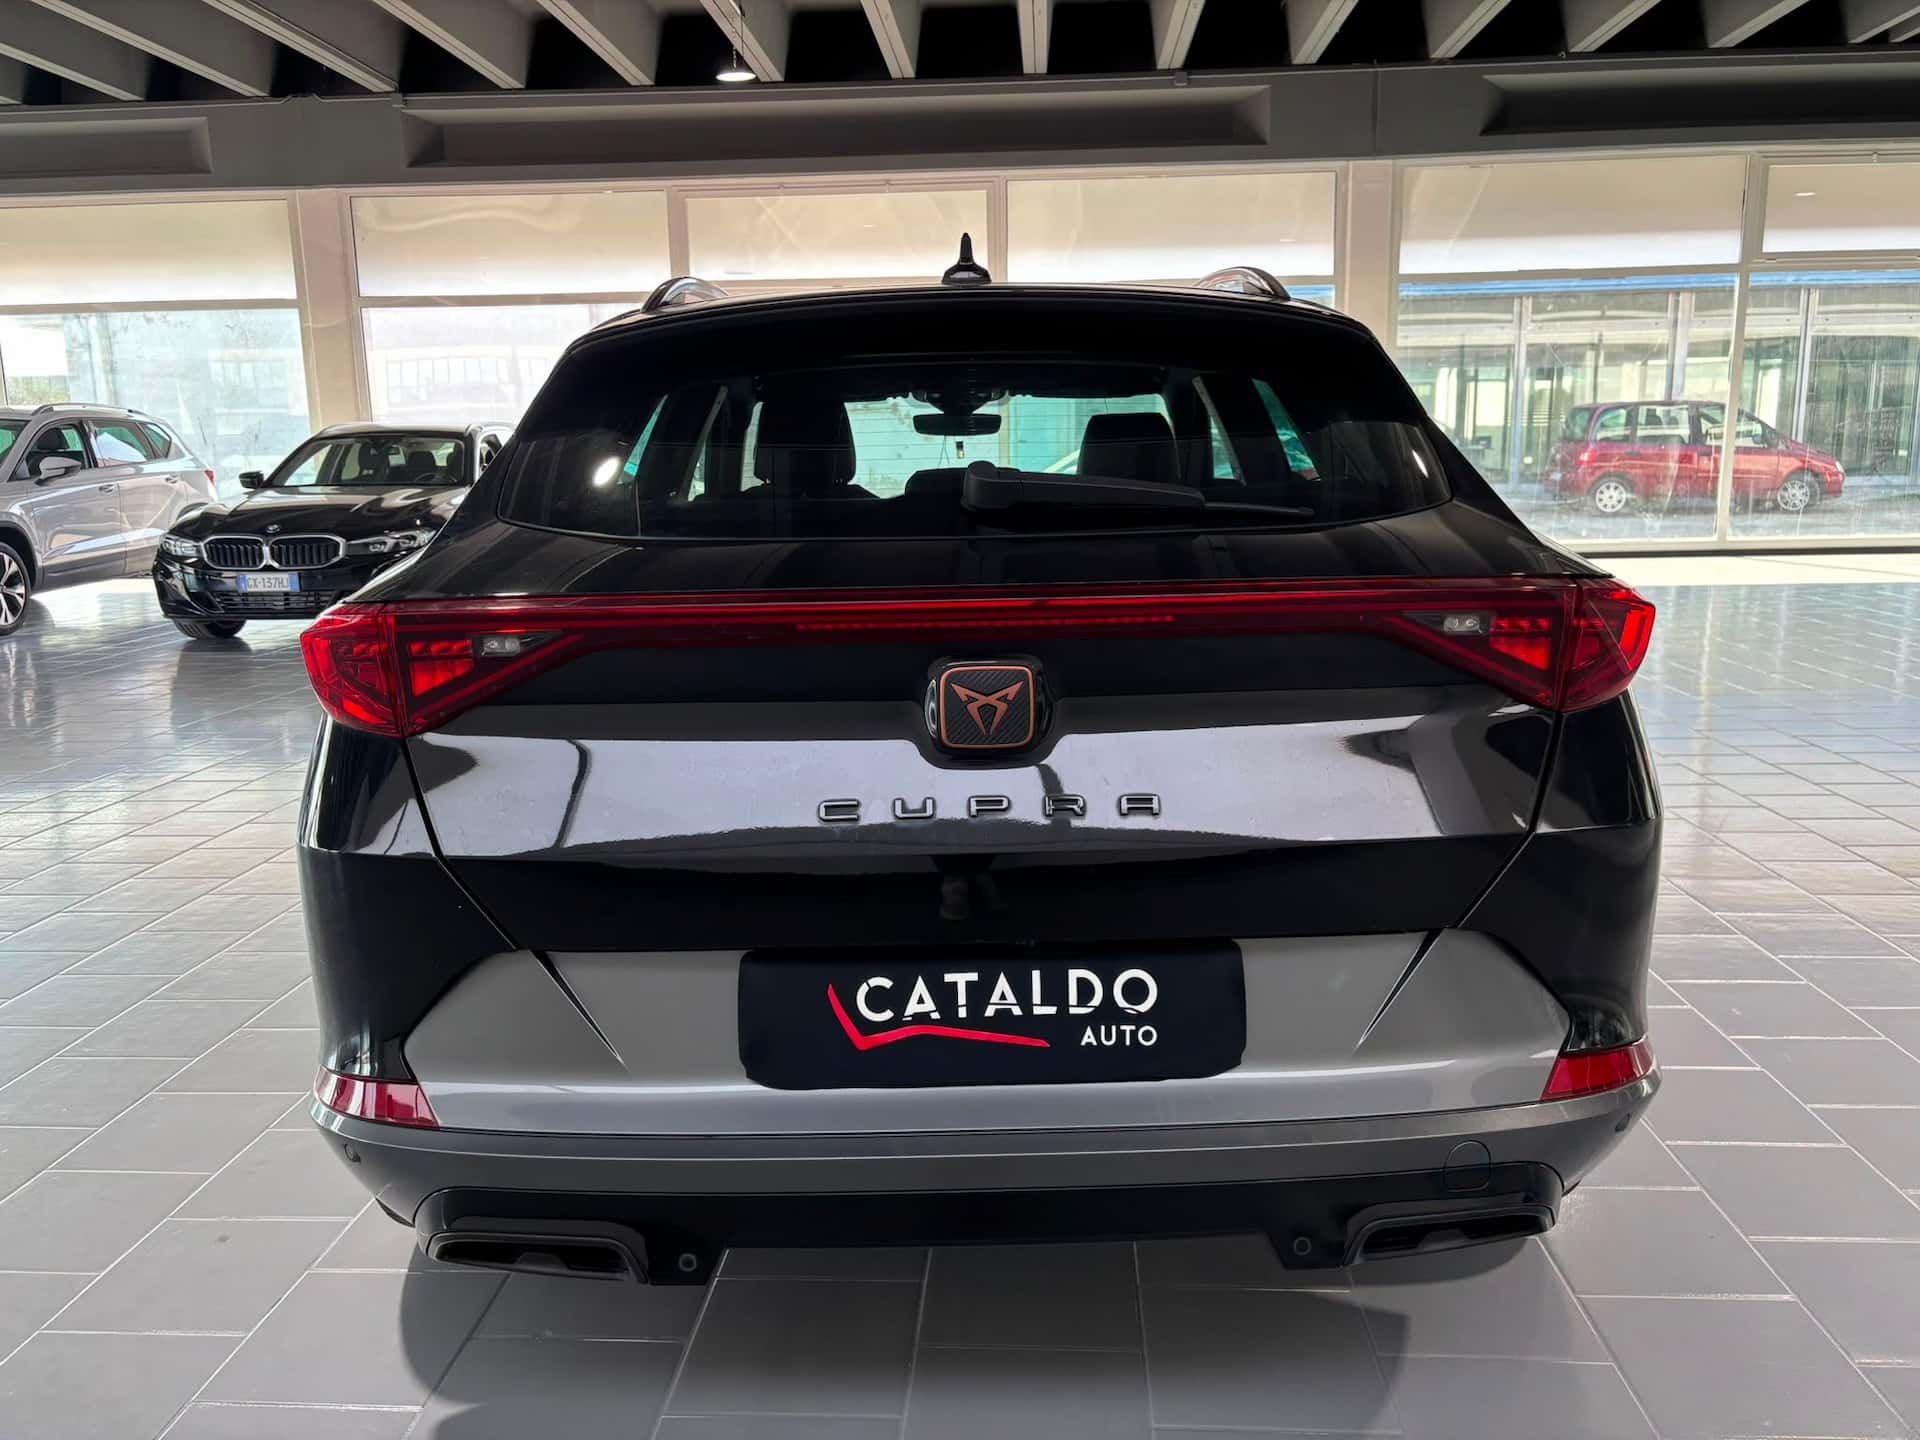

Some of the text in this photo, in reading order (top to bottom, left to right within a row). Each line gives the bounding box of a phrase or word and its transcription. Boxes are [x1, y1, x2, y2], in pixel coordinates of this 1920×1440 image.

[818, 794, 1161, 823] CUPRA
[856, 968, 1158, 1022] CATALDO
[1080, 1025, 1157, 1046] AUTO
